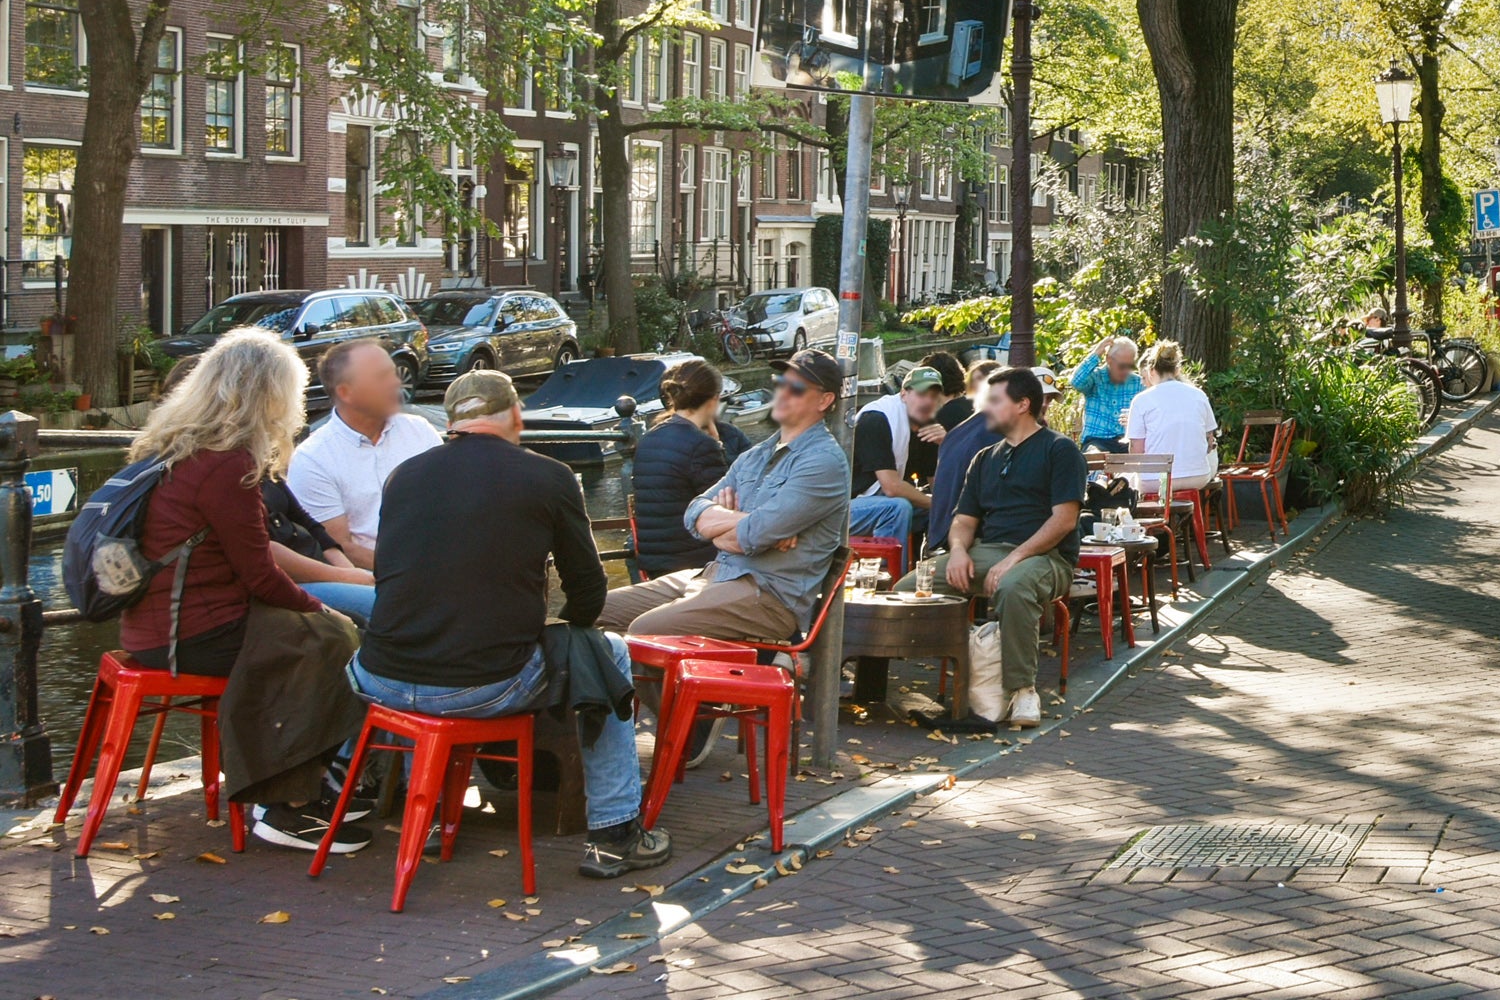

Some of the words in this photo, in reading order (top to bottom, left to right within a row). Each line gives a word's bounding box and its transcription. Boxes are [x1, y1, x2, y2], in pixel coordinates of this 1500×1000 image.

[1480, 193, 1495, 215] P
[225, 216, 249, 224] STORY
[25, 484, 51, 508] ,50
